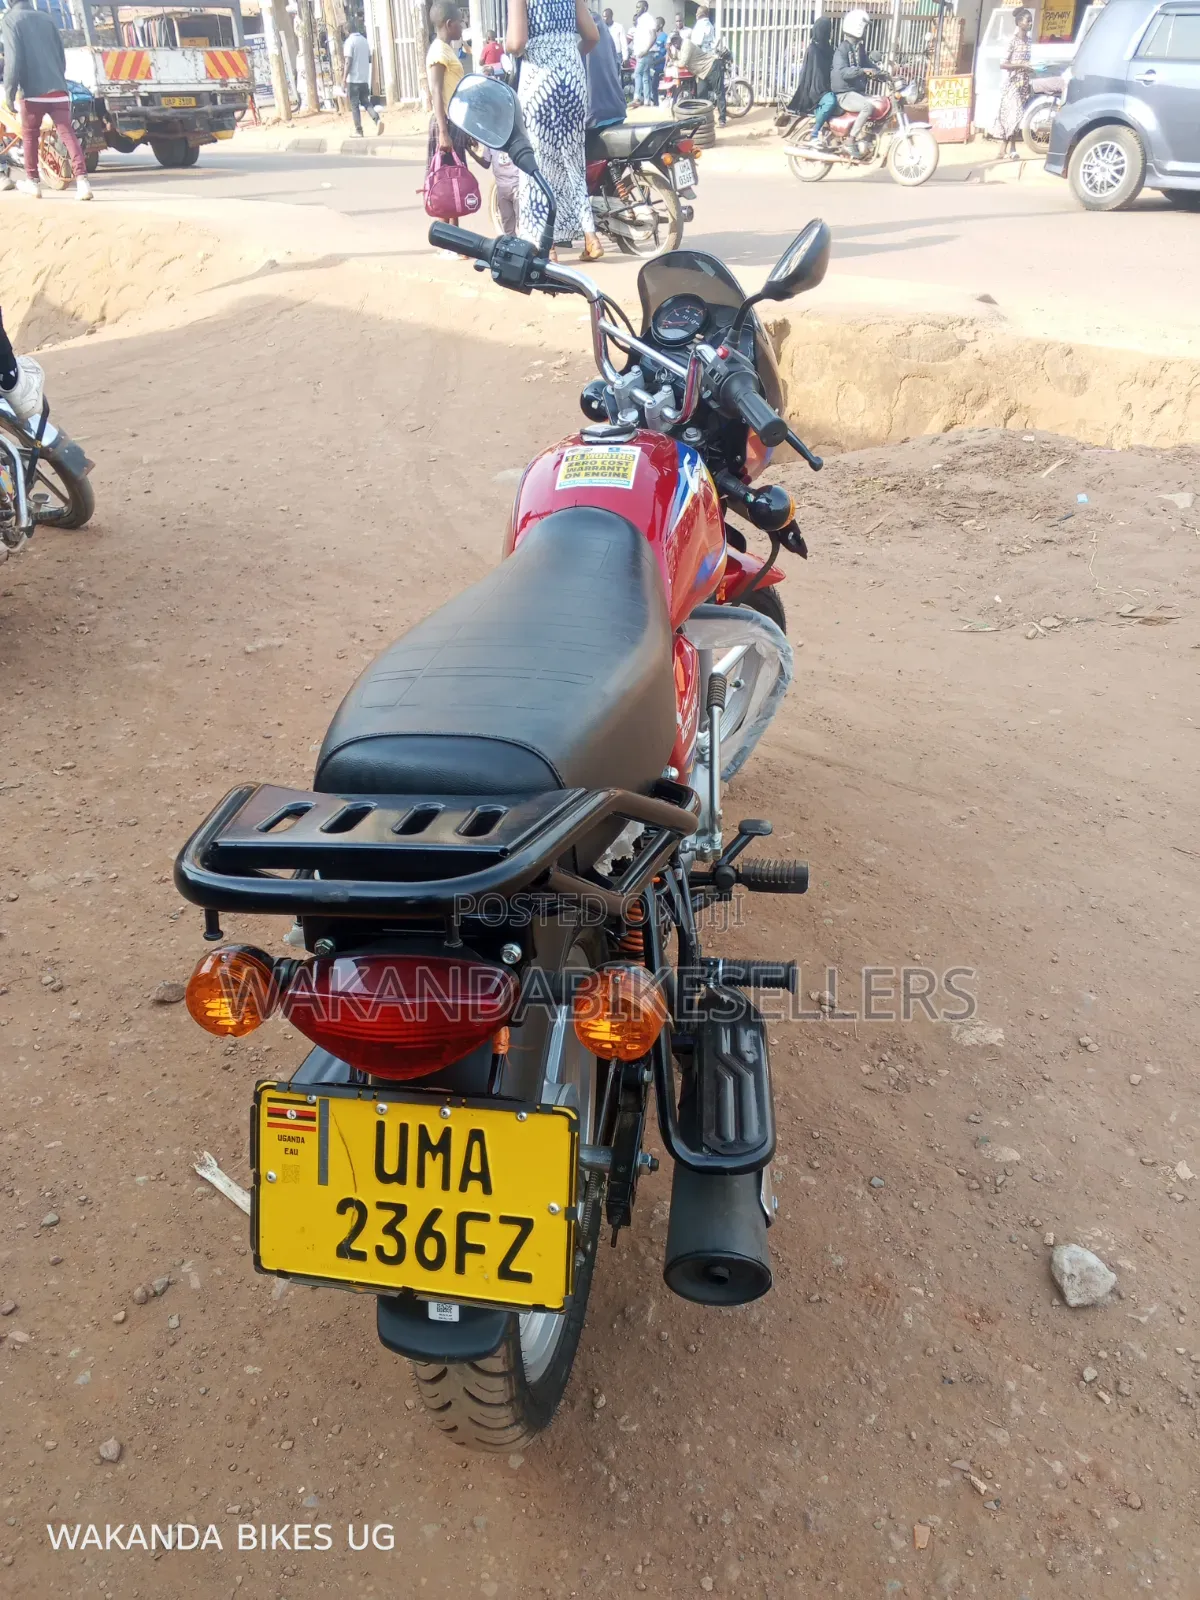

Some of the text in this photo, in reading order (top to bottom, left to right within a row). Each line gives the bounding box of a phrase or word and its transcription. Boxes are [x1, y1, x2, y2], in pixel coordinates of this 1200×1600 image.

[584, 471, 629, 479] ENGINE
[277, 1134, 306, 1144] UGANDA
[284, 1147, 299, 1156] EAU
[374, 1120, 492, 1195] UMA
[335, 1197, 534, 1284] 236FZ
